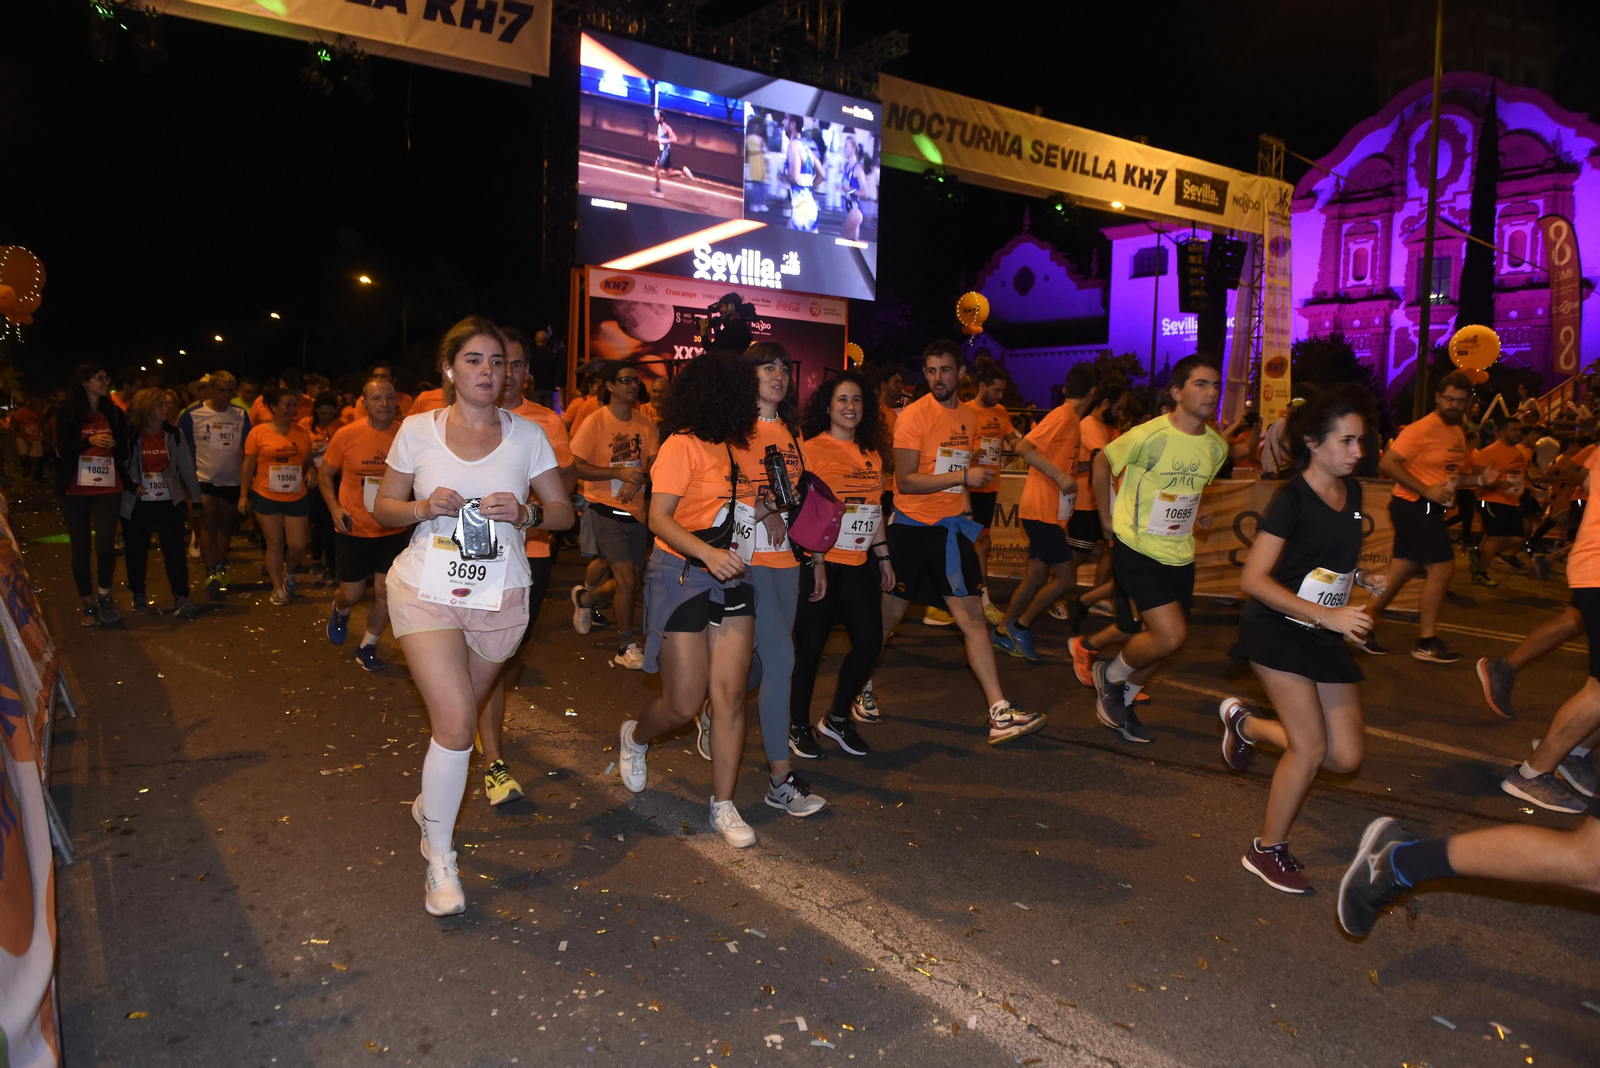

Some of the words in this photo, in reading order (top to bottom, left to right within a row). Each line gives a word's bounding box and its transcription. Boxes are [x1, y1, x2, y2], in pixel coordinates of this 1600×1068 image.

[886, 102, 1023, 160] NOCTURNA
[1029, 139, 1117, 183] SEVILLA
[643, 284, 658, 293] ABC
[665, 288, 697, 299] Cruzcampo
[88, 466, 109, 475] 18022
[277, 474, 297, 482] 15566
[1165, 508, 1193, 519] 10695
[851, 520, 874, 532] 4713
[447, 561, 487, 581] 3699
